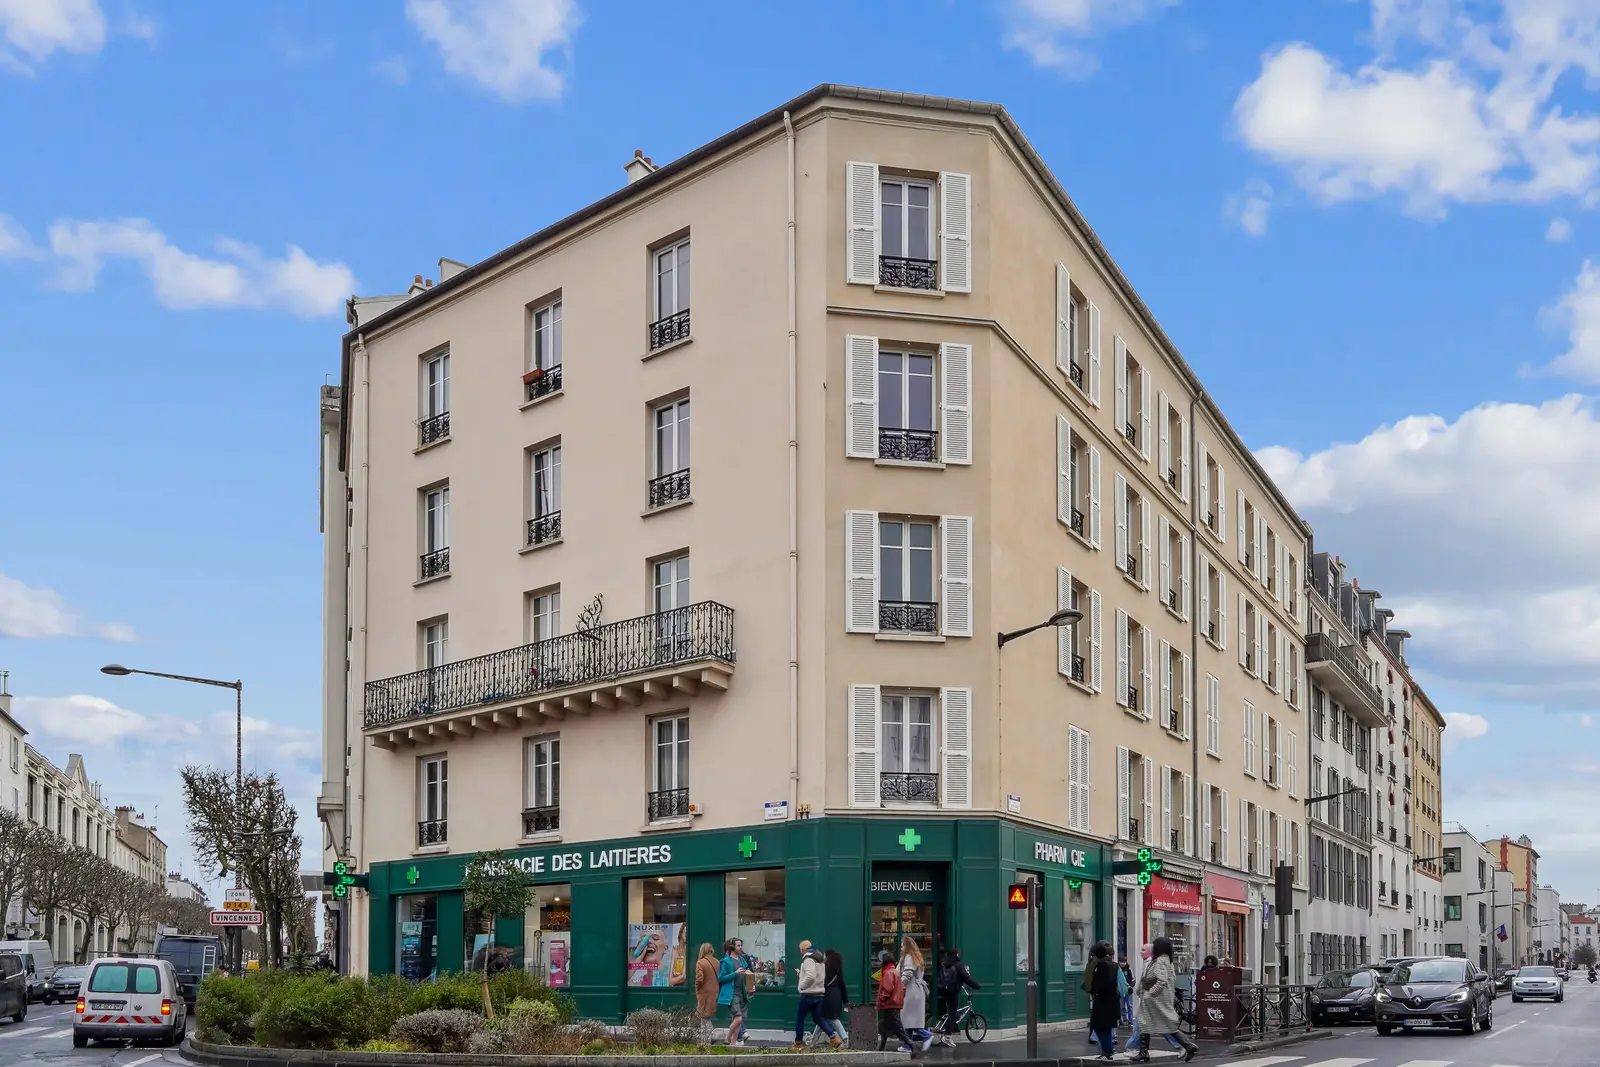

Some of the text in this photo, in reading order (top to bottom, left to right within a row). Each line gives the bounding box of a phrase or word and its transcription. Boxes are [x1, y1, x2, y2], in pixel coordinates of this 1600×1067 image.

[552, 853, 582, 871] DES
[590, 845, 672, 869] LAITIERES
[871, 881, 932, 891] BIENVENUE
